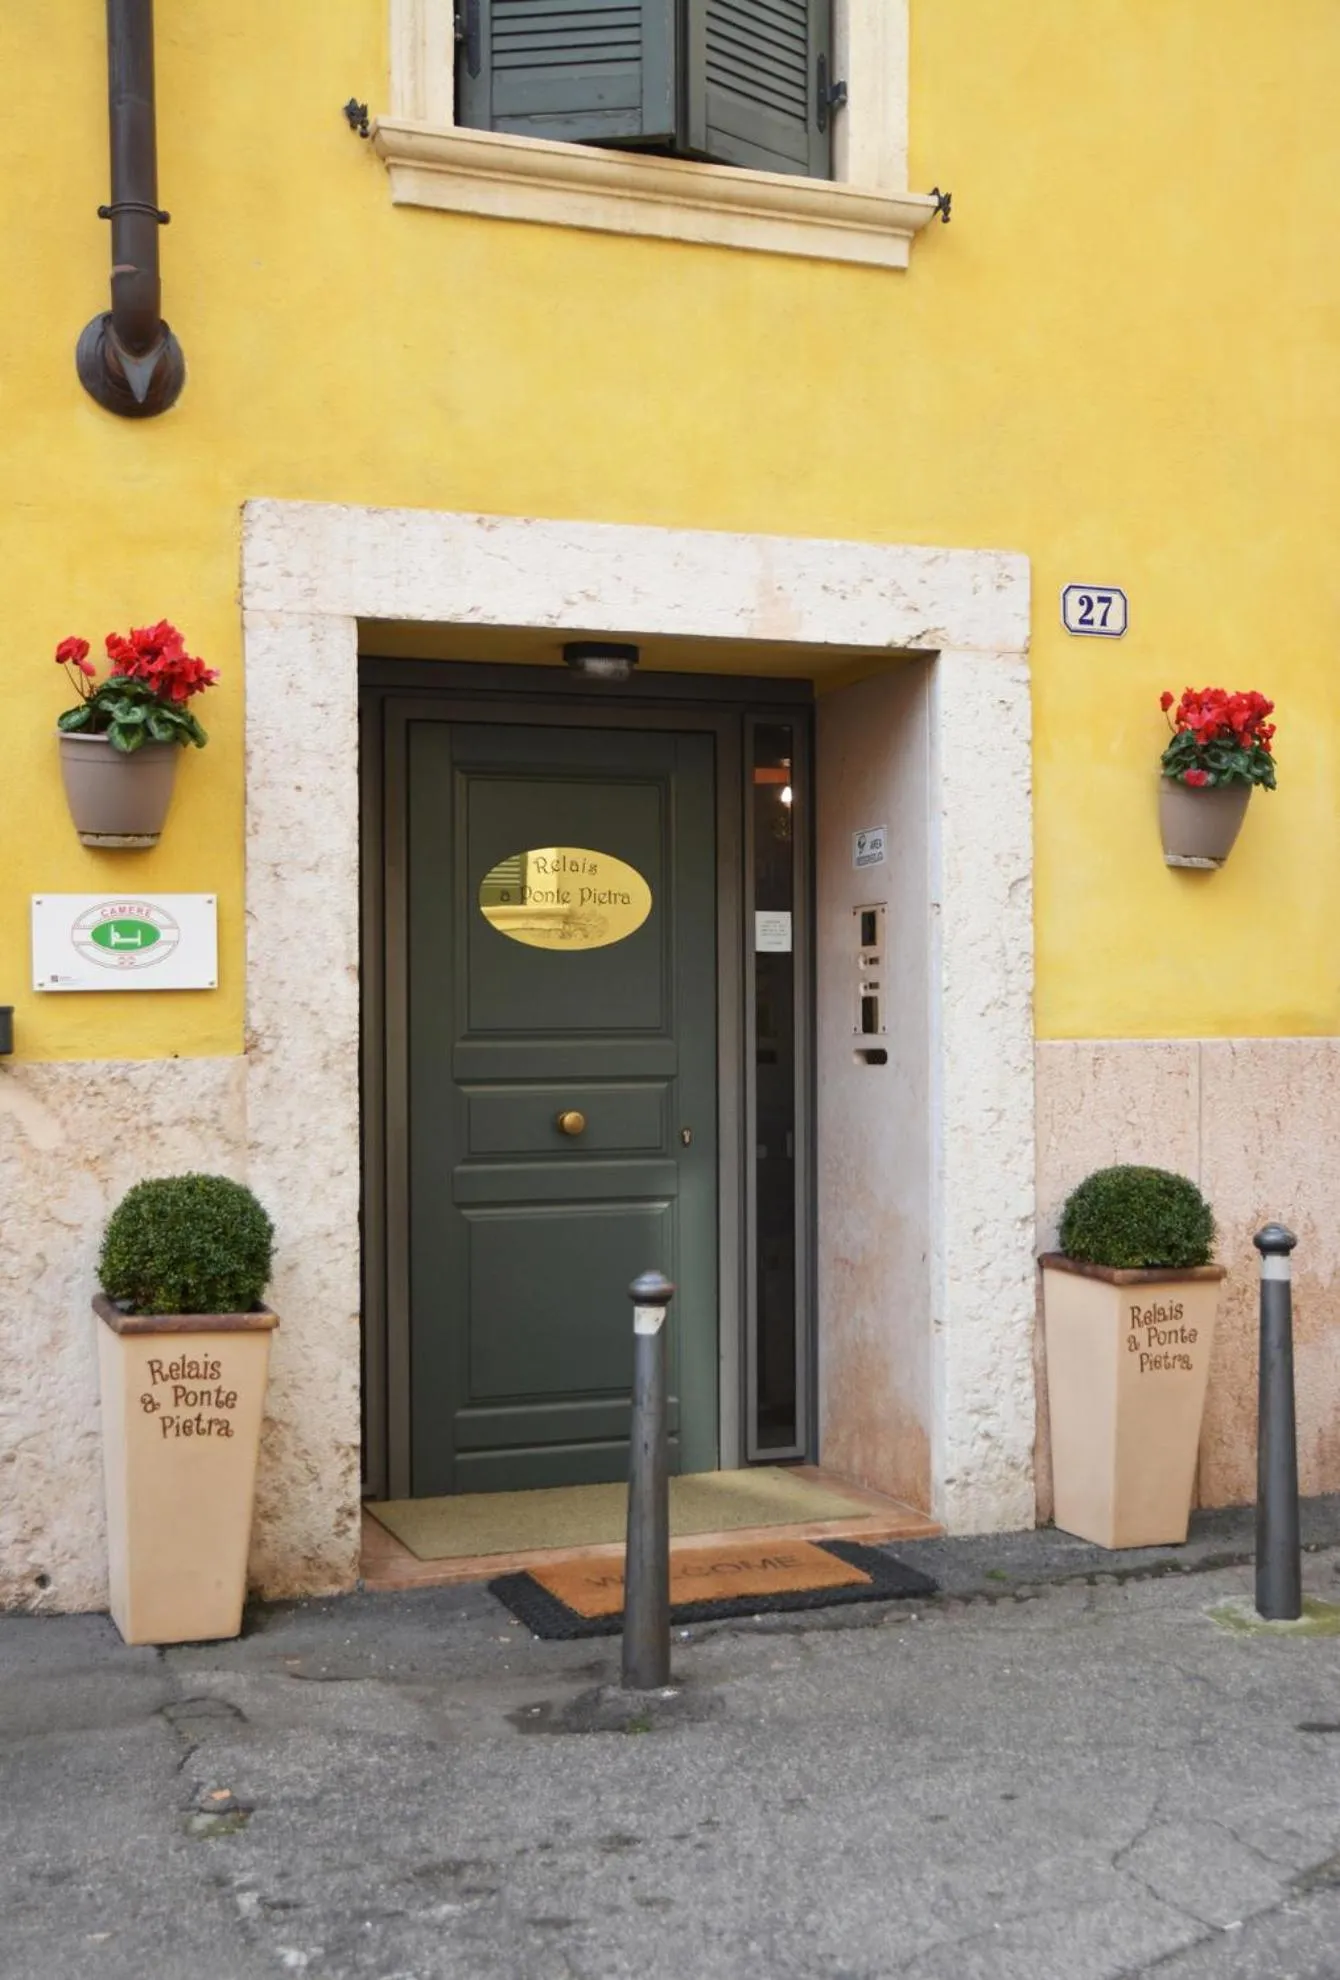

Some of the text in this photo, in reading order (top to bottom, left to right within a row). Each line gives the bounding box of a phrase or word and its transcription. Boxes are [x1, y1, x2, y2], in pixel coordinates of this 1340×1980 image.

[1079, 595, 1112, 626] 27
[533, 855, 598, 875] Relais
[500, 885, 631, 906] a Ponte Pietra
[100, 905, 152, 919] CAMERE
[1130, 1300, 1184, 1329] Relais
[1147, 1325, 1198, 1348] Ponte
[147, 1353, 221, 1385] Relais
[1140, 1352, 1193, 1373] Pietra
[171, 1385, 237, 1409] Ponte
[159, 1412, 234, 1439] Pietra
[584, 1554, 797, 1588] WCOME
